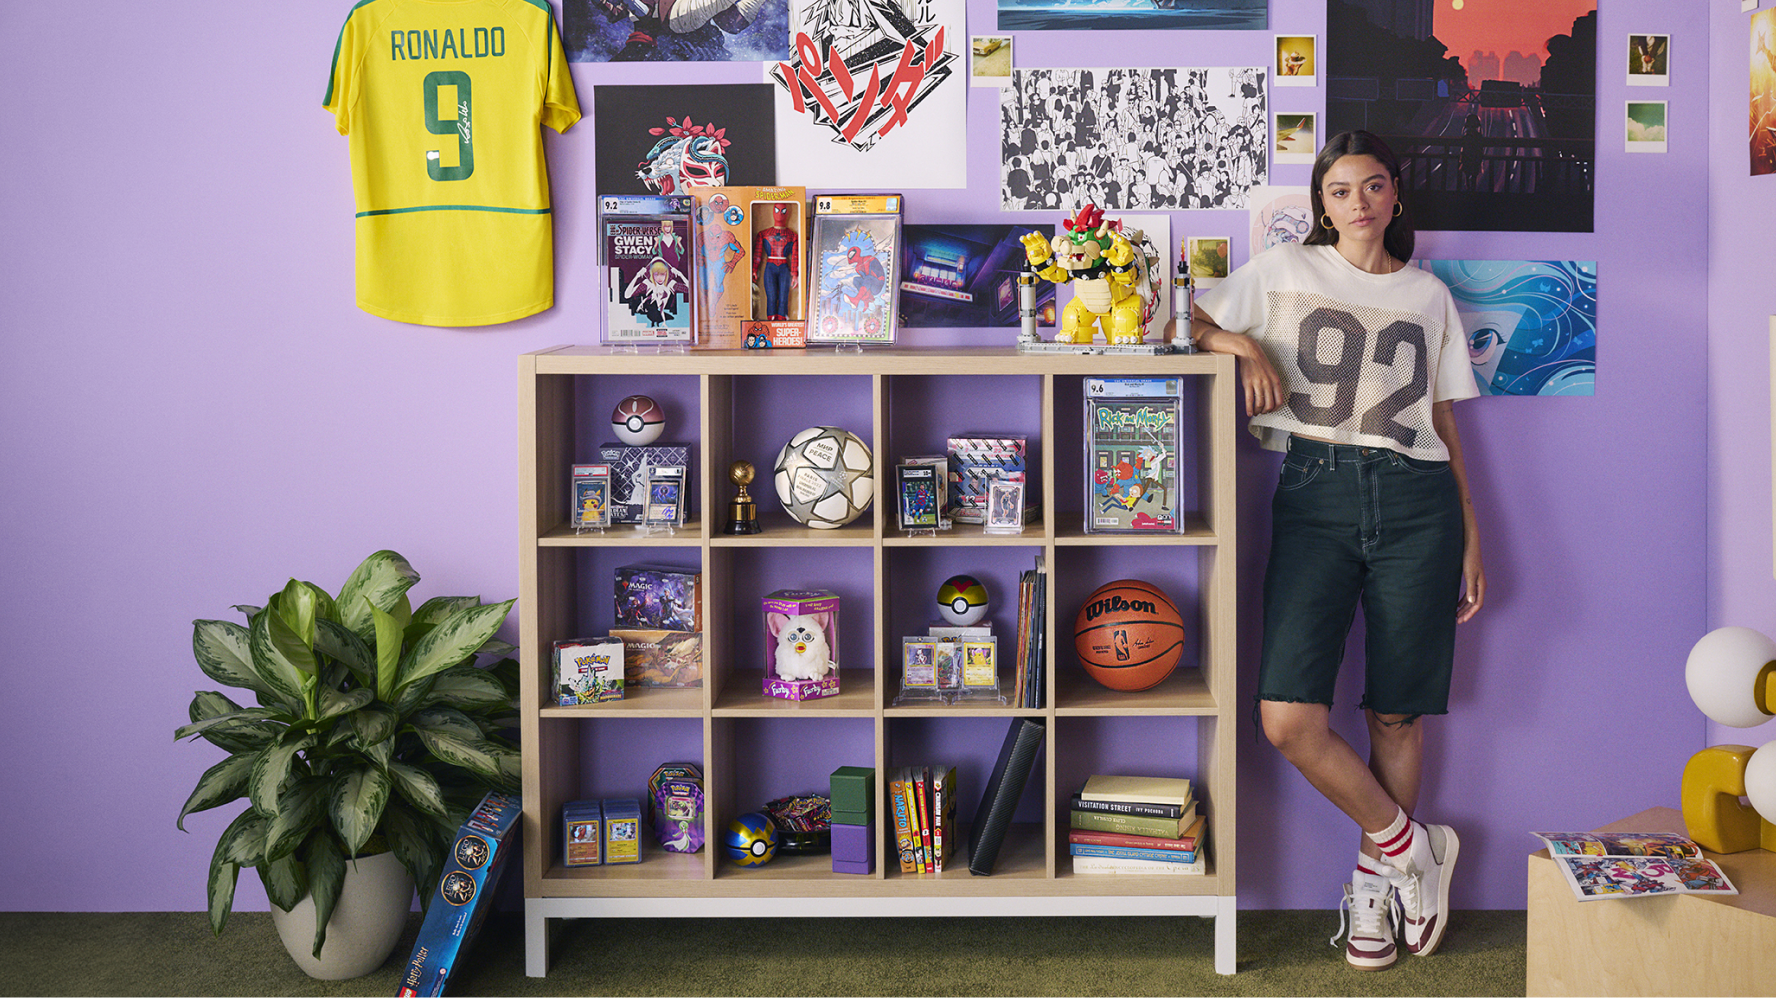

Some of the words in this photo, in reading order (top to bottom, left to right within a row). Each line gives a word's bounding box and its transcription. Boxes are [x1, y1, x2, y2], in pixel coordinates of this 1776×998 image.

[391, 26, 506, 60] RONALDO
[778, 25, 945, 144] パンダ
[423, 70, 475, 182] 9
[605, 201, 618, 210] 9.2
[819, 201, 831, 210] 9.8
[614, 236, 653, 245] GWEN
[614, 245, 653, 255] STACY
[776, 328, 802, 337] SUPER-
[773, 337, 803, 346] HEROES!
[1288, 307, 1429, 449] 92
[1091, 384, 1104, 393] 9.6
[809, 448, 832, 462] PEACE
[628, 582, 653, 590] MAGIC
[1086, 596, 1157, 621] Wilson
[894, 794, 907, 828] NARUTO
[1078, 801, 1109, 810] VISITATION
[1110, 804, 1131, 813] STREET
[411, 946, 429, 968] Potter
[406, 966, 423, 987] Harry
